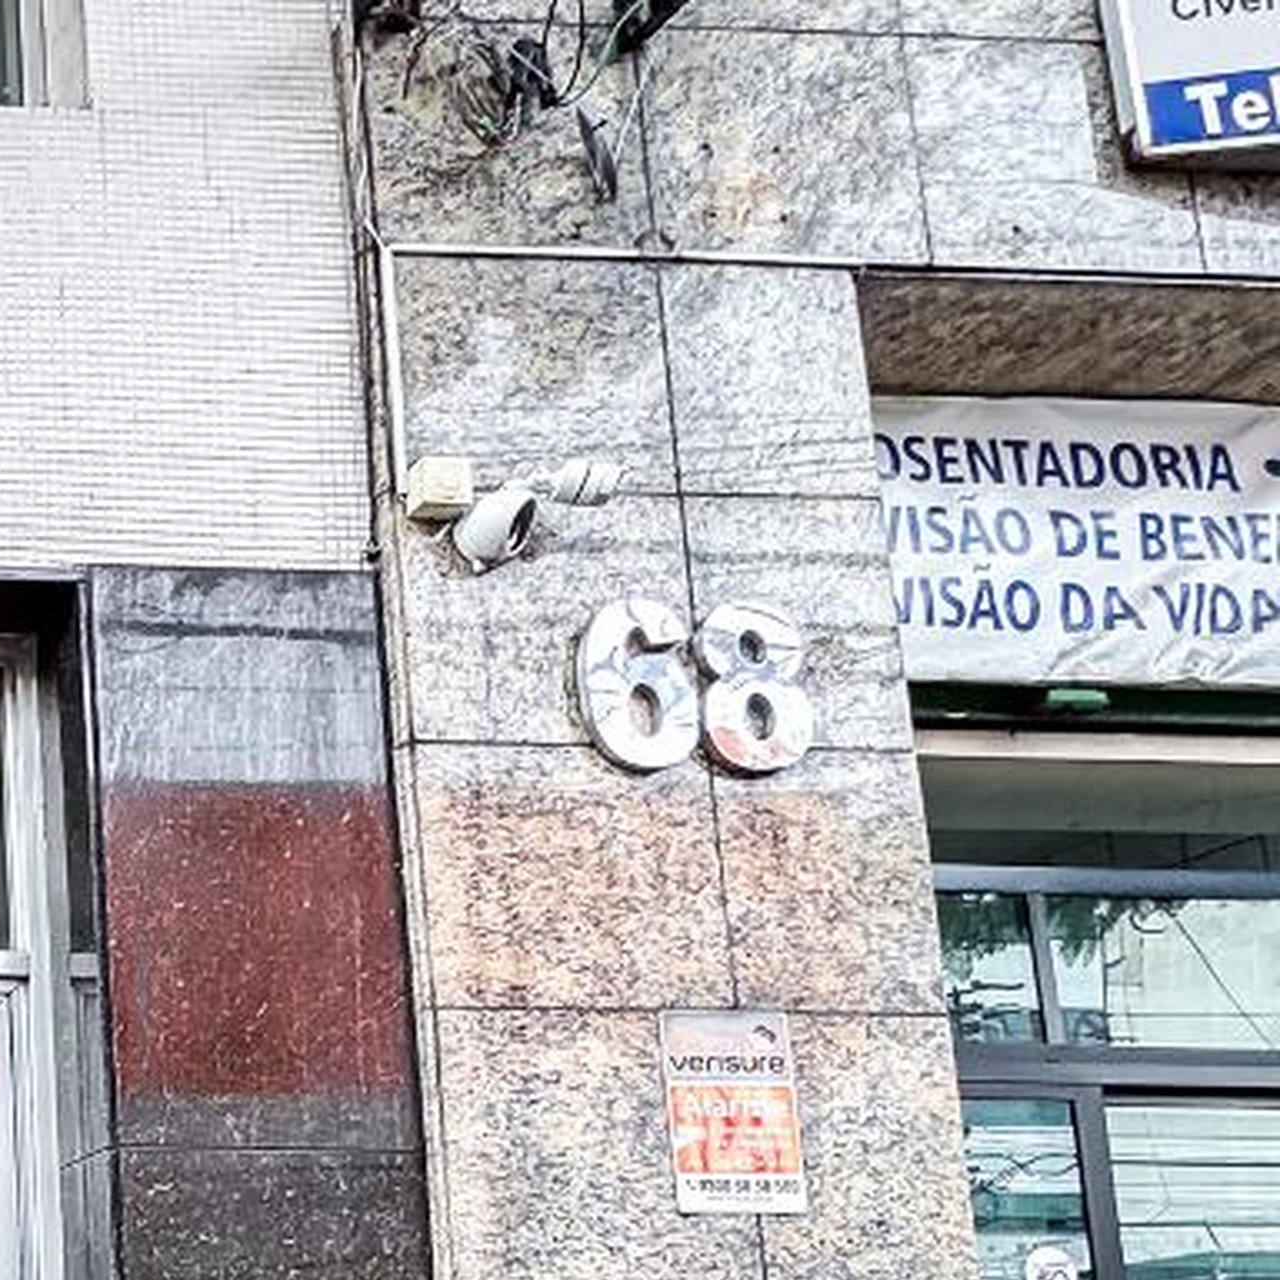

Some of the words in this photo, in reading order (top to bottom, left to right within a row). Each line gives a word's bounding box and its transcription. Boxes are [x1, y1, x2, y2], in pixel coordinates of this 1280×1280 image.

[1049, 509, 1121, 561] DE
[1059, 582, 1147, 633] DA
[578, 597, 815, 778] 68
